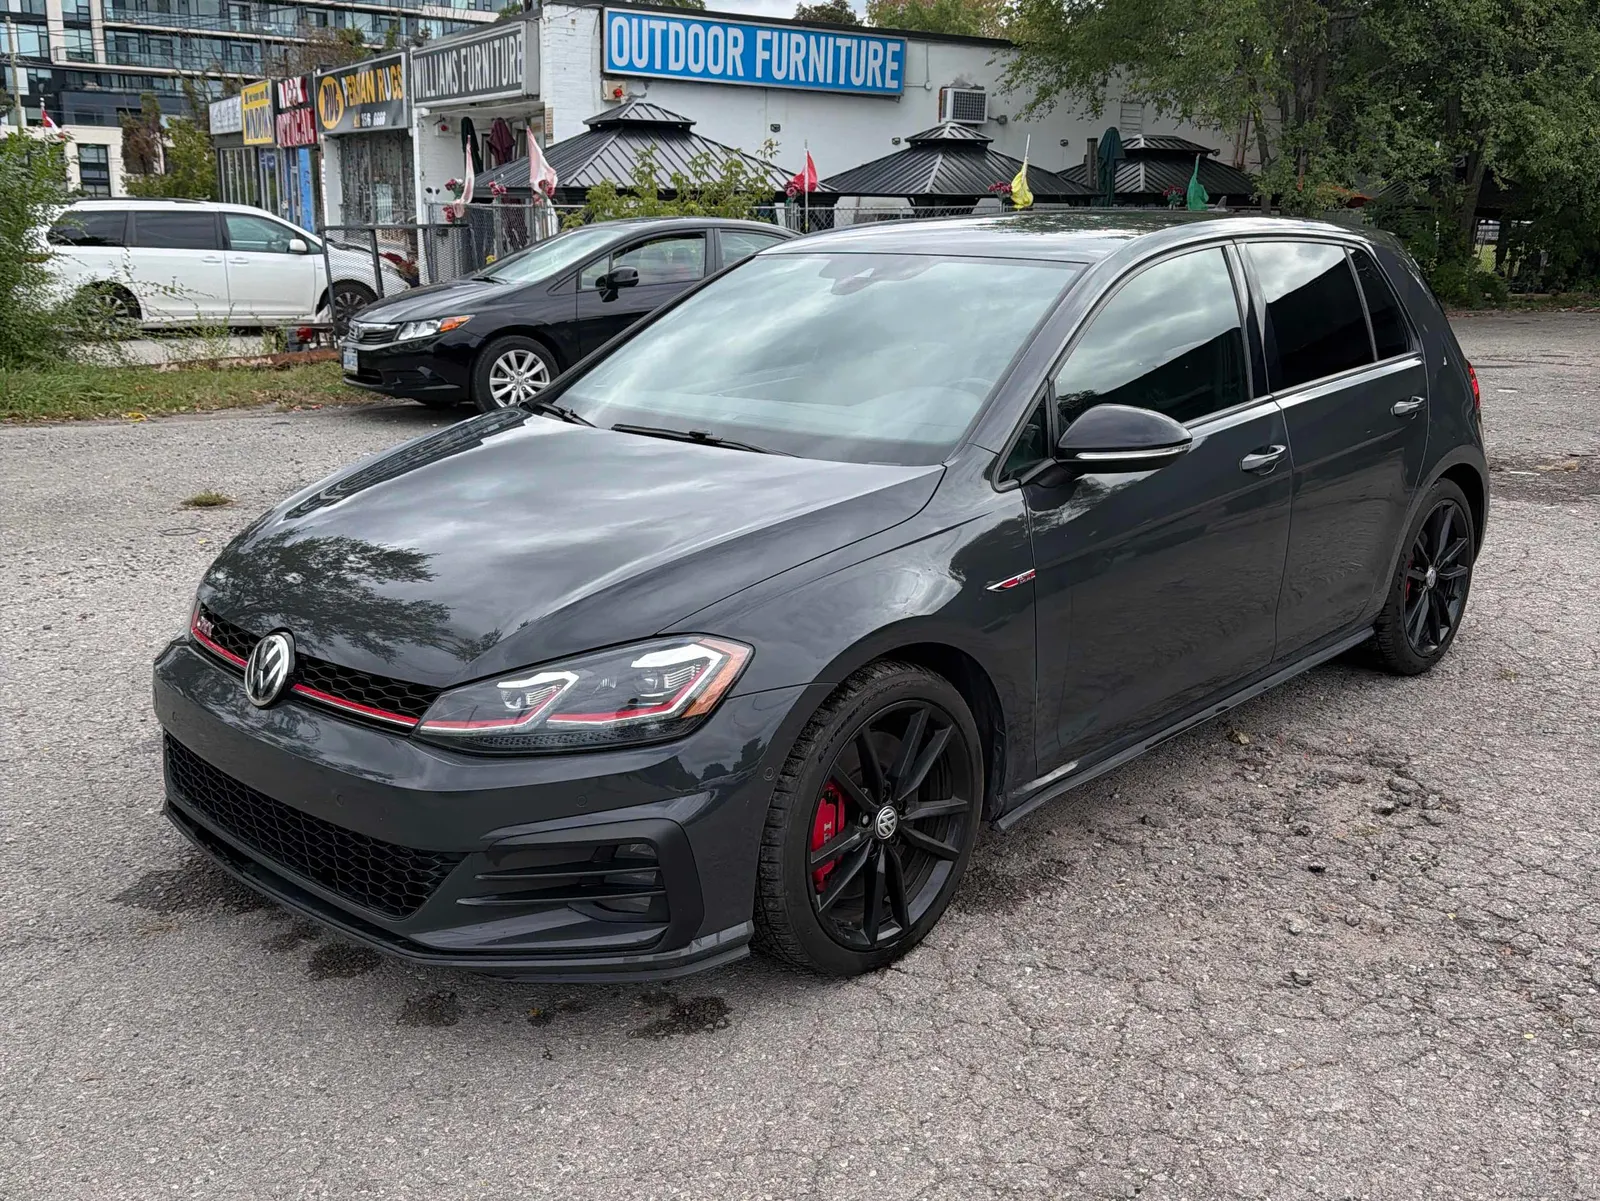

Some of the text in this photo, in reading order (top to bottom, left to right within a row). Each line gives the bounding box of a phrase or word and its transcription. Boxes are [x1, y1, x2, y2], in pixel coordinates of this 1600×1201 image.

[376, 64, 403, 103] RUGS
[413, 33, 523, 99] WILLIAMS FURNITURE
[610, 16, 901, 89] OUTDOOR FURNITURE
